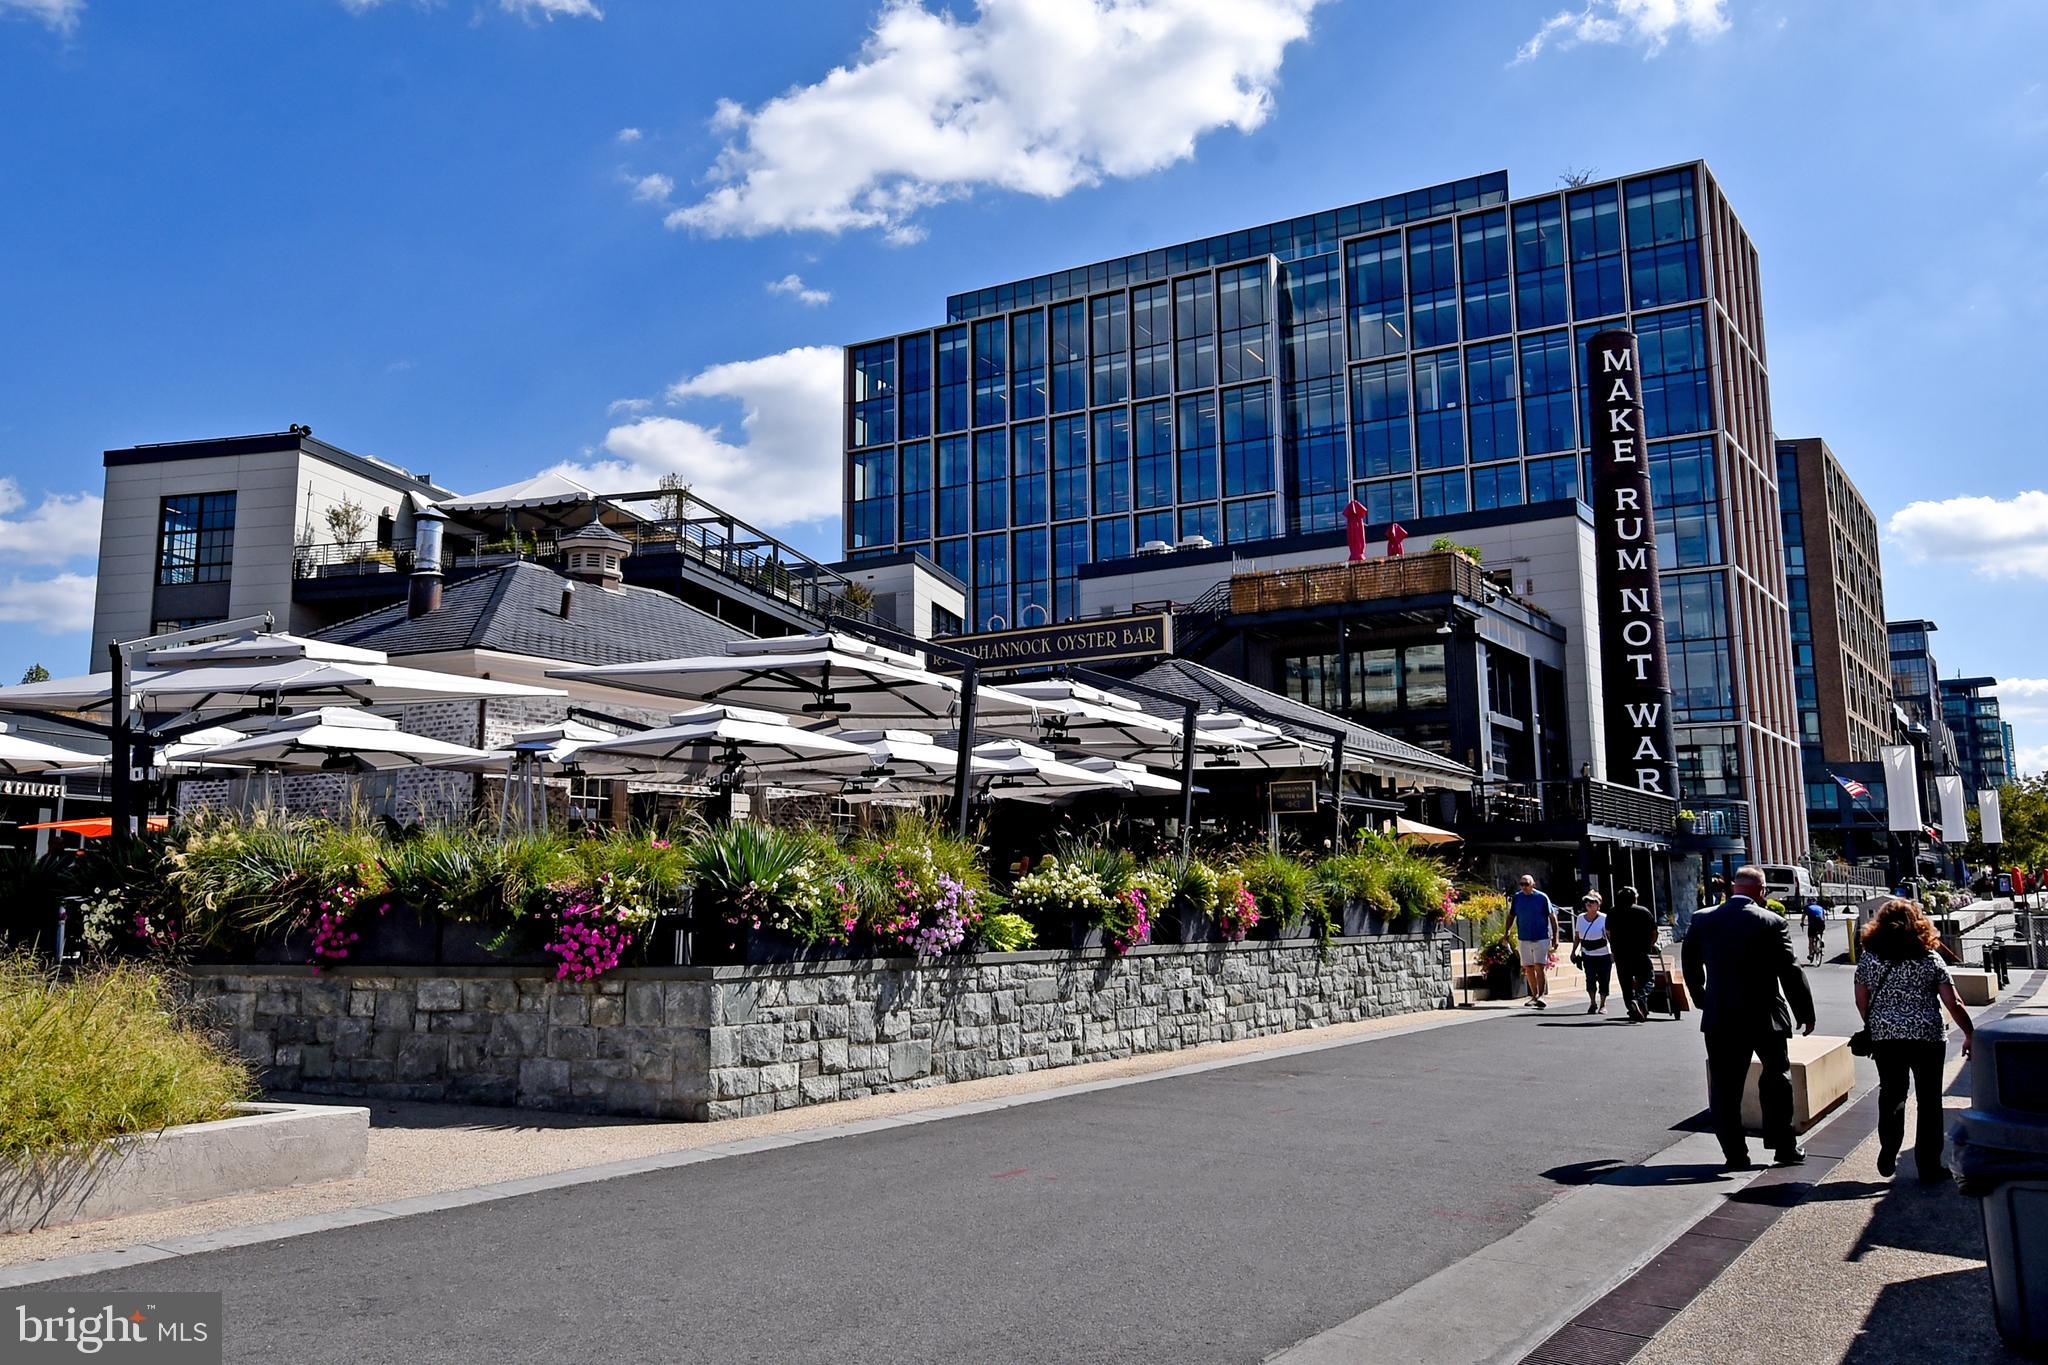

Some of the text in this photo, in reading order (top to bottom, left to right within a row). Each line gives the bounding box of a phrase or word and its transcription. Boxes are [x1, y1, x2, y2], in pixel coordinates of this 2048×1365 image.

[1602, 348, 1664, 792] MAKE RUM NOT WAR
[933, 626, 1156, 667] RPAHANNOCK OYSTER BAR
[15, 781, 67, 798] FALAFEL
